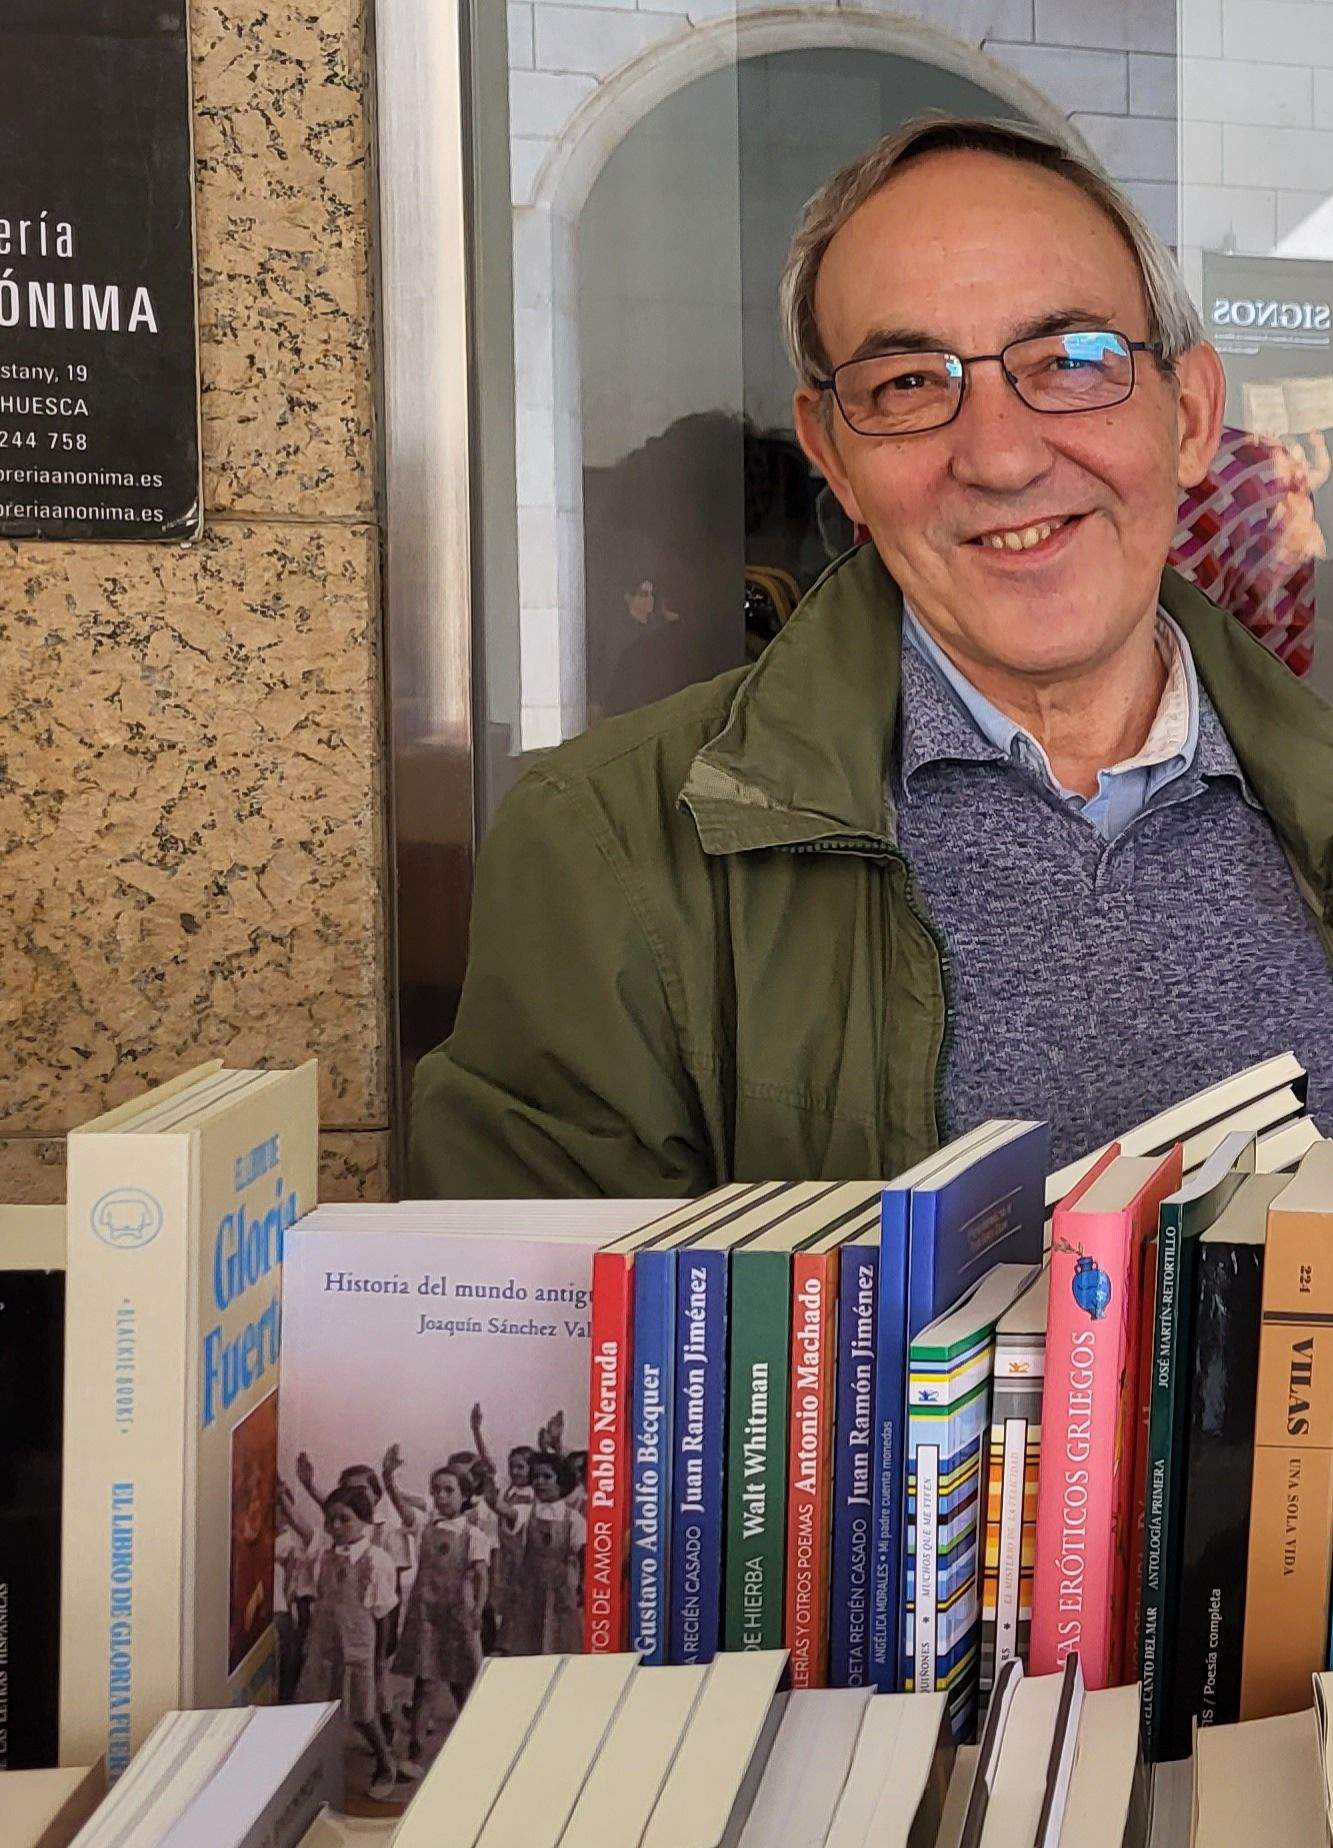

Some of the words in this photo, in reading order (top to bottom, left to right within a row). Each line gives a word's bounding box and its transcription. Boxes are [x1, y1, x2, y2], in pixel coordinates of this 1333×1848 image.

[0, 268, 157, 334] ÓNIMA
[0, 365, 59, 383] stany,
[0, 397, 89, 416] HUESCA
[0, 431, 36, 448] 244
[48, 433, 87, 450] 758
[324, 1272, 410, 1294] Historia
[417, 1275, 447, 1296] del
[455, 1279, 527, 1301] mundo
[683, 1267, 708, 1364] Jiménez
[1159, 1226, 1177, 1357] MARTÍN-RETORTILLO
[115, 1308, 136, 1371] BLACKIE
[417, 1314, 482, 1336] Joaquín
[488, 1316, 557, 1337] Sánchez
[796, 1277, 821, 1390] Machado
[115, 1377, 134, 1424] BOOKS
[594, 1340, 618, 1433] Neruda
[637, 1363, 666, 1464] Bécquer
[682, 1368, 705, 1452] Ramón
[744, 1362, 769, 1477] Whitman
[1066, 1330, 1097, 1464] GRIEGOS
[1286, 1336, 1315, 1438] VILAS
[591, 1438, 616, 1508] Pablo
[794, 1395, 819, 1496] Antonio
[111, 1482, 134, 1509] EL
[635, 1467, 659, 1552] Adolfo
[680, 1457, 706, 1513] Juan
[742, 1482, 767, 1540] Walt
[111, 1514, 134, 1584] LIBRO
[593, 1521, 613, 1584] AMOR
[685, 1524, 701, 1594] CASADO
[798, 1503, 817, 1568] POEMAS
[1054, 1470, 1090, 1615] ERÓTICOS
[634, 1558, 658, 1656] Gustavo
[743, 1555, 764, 1628] HIERBA
[795, 1570, 812, 1620] OTROS
[876, 1563, 889, 1616] MORALES
[1208, 1589, 1223, 1648] completa
[109, 1620, 133, 1711] GLORIA
[1203, 1652, 1218, 1695] Poesía
